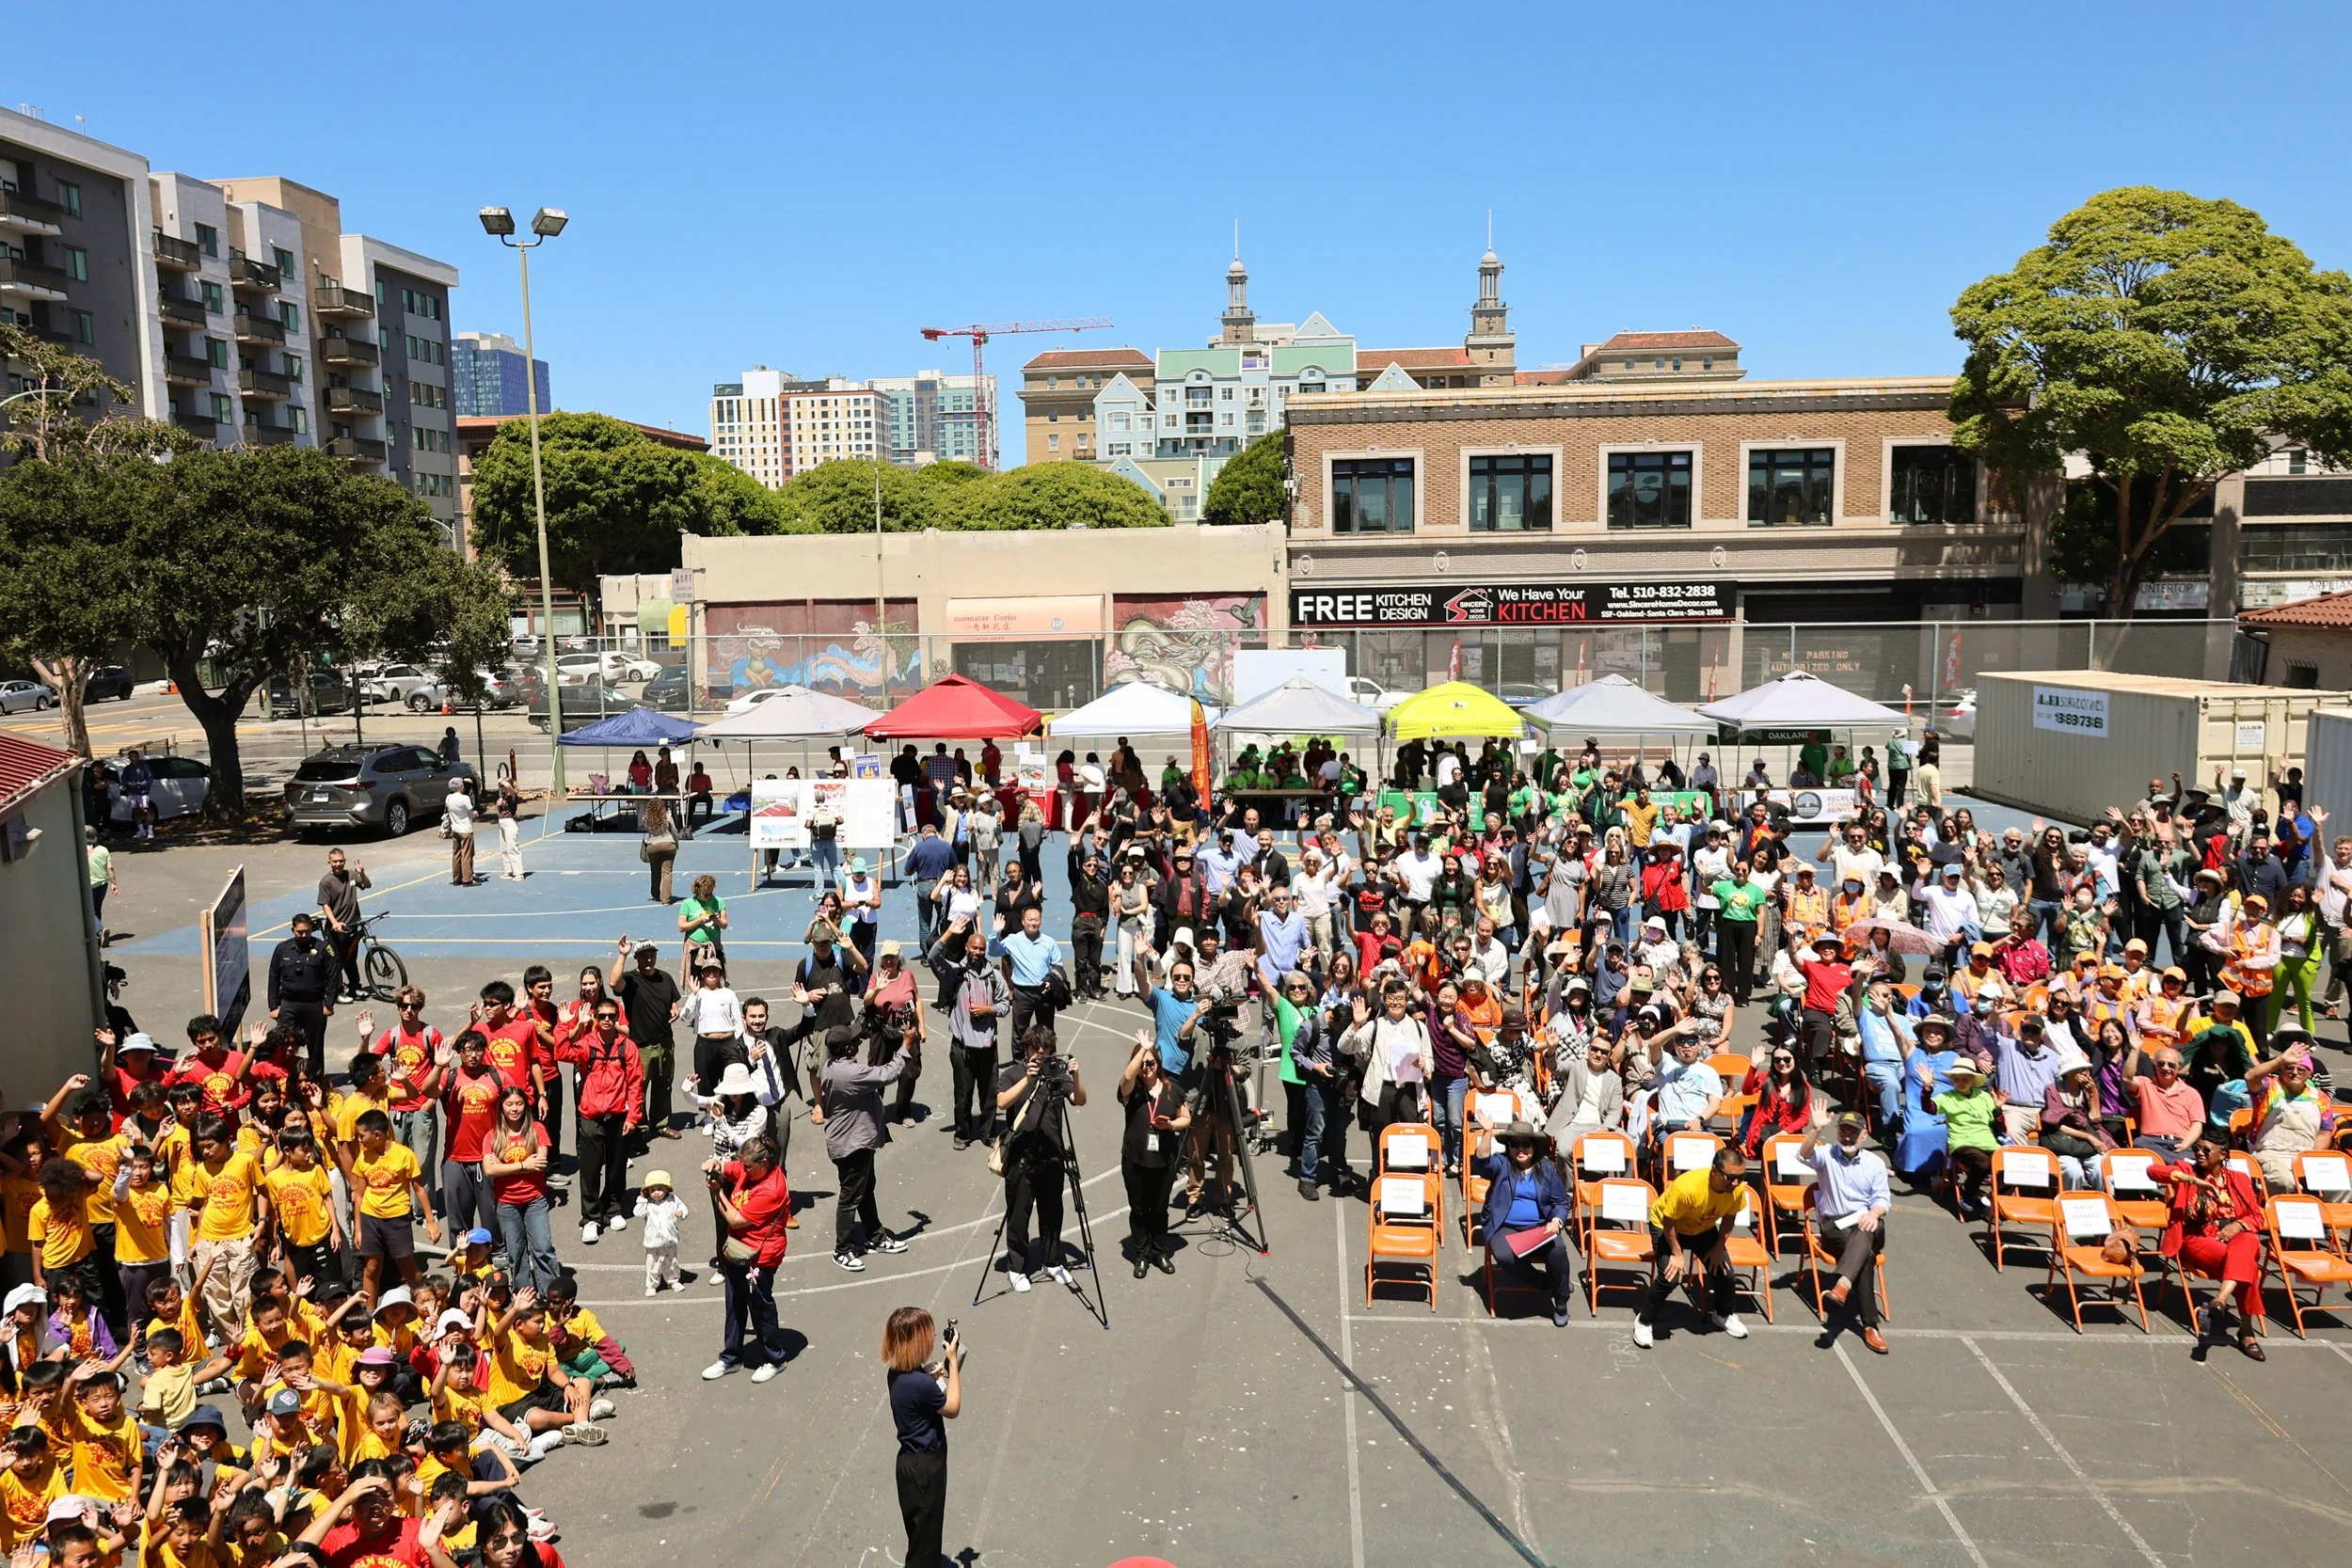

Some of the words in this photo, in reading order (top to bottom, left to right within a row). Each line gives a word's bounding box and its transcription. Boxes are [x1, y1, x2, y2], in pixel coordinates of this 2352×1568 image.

[1498, 589, 1518, 600] We
[1522, 589, 1553, 600] Have
[1556, 588, 1585, 600] Your
[1610, 587, 1630, 598] Tel.
[1632, 585, 1715, 598] 510-832-2838
[2139, 583, 2193, 594] UNTERTOP
[1298, 594, 1373, 621] FREE
[1376, 594, 1431, 606] KITCHEN
[1607, 599, 1718, 609] www.SincereHomeDecor.com
[1379, 608, 1427, 621] DESIGN
[1498, 602, 1585, 621] KITCHEN
[1806, 651, 1849, 659] PARKING
[1836, 662, 1860, 671] ONLY
